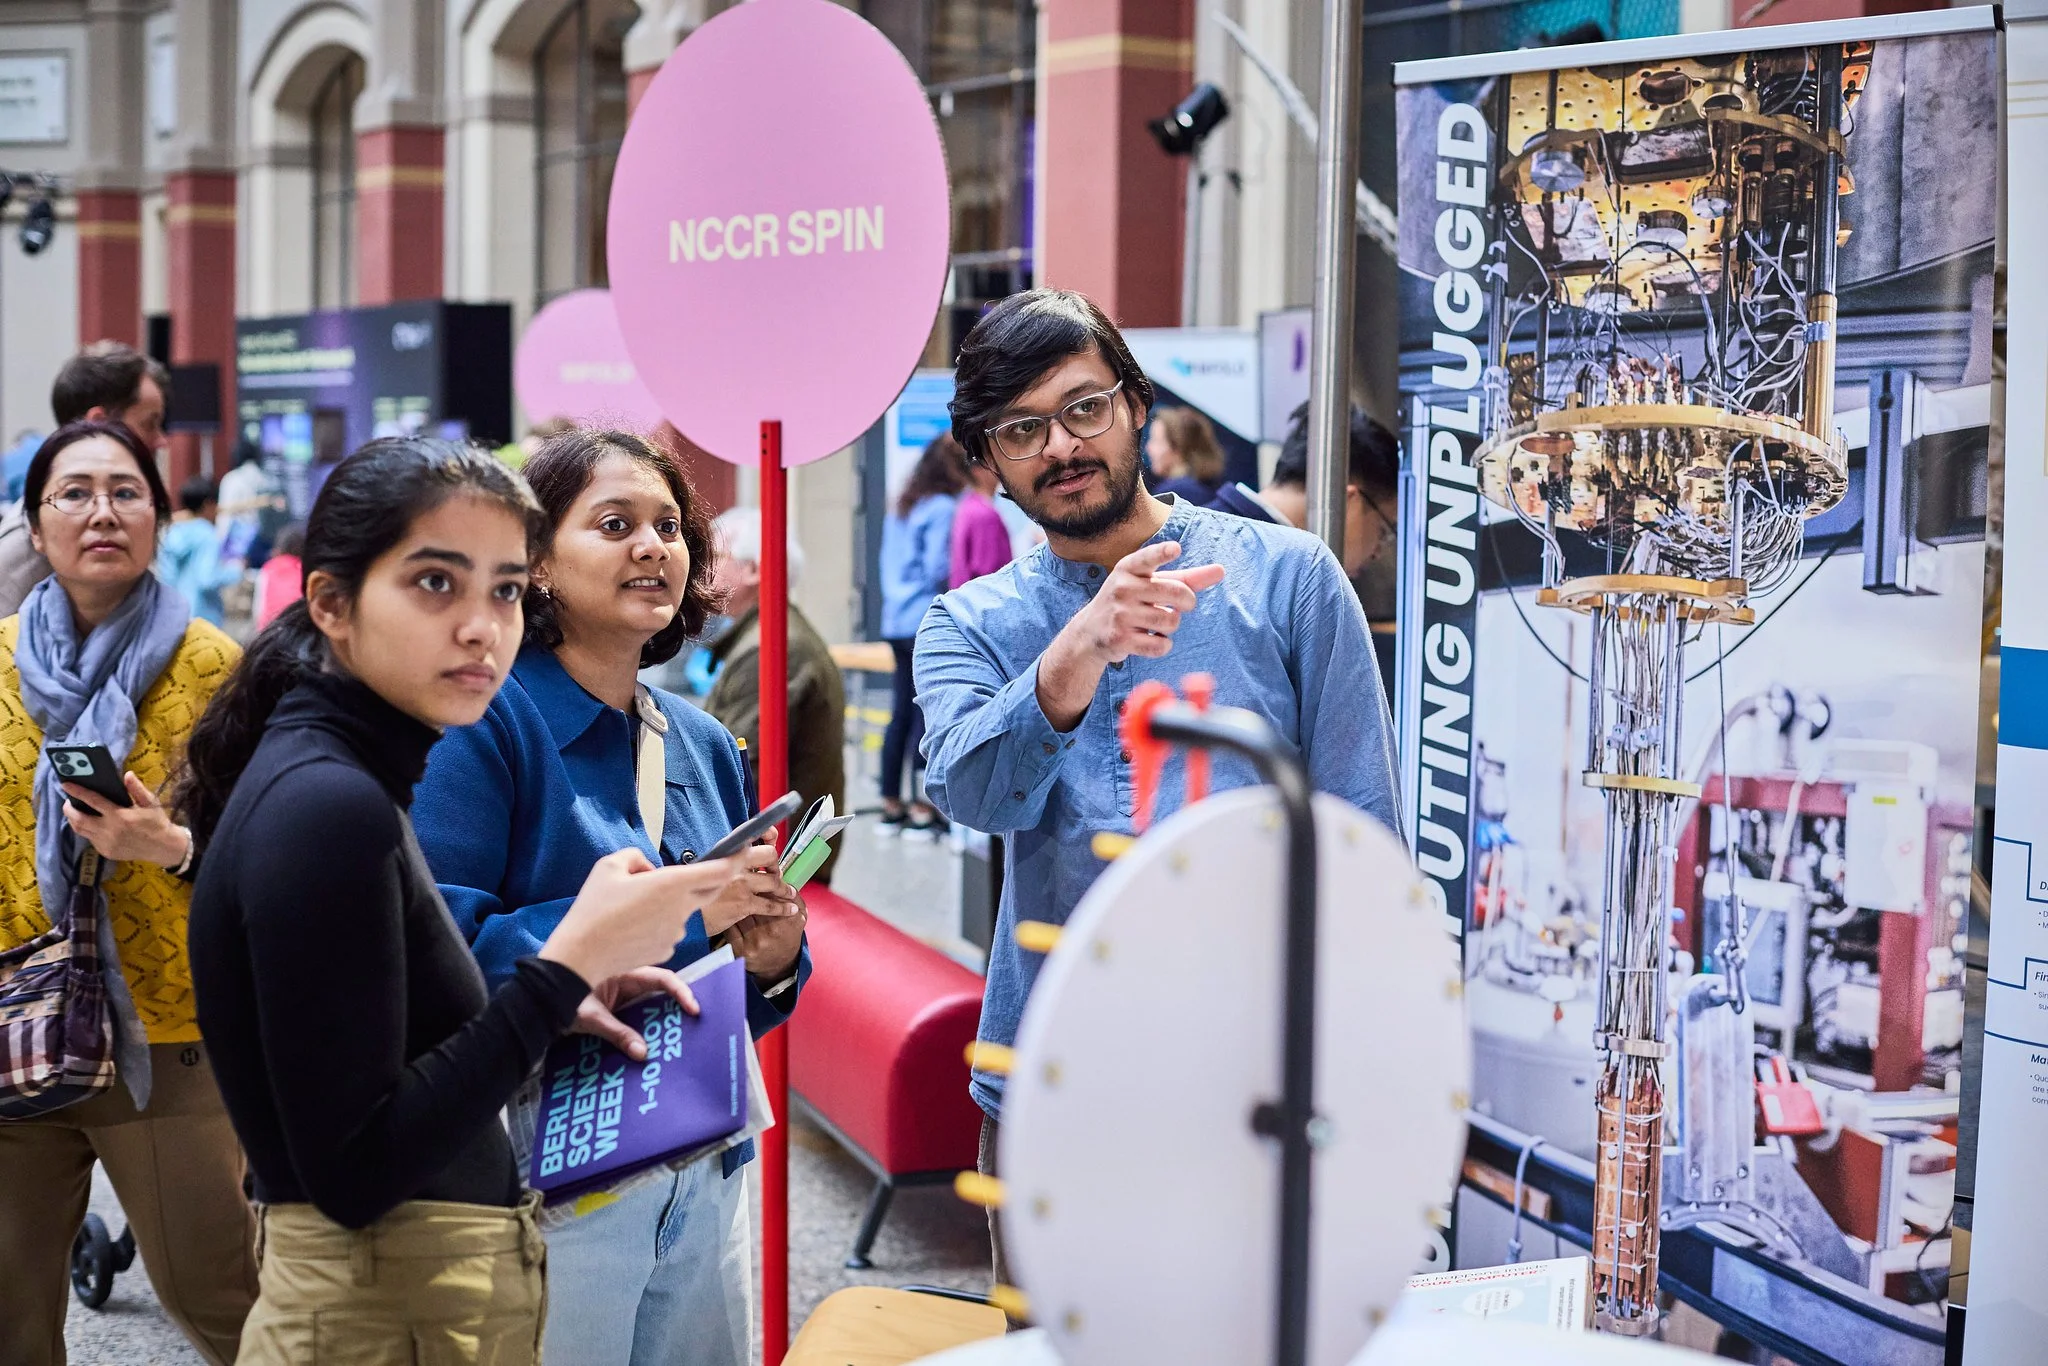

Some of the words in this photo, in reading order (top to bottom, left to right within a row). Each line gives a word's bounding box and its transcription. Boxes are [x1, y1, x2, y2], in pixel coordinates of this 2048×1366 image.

[669, 212, 780, 263] NCCR
[786, 205, 884, 256] SPIN
[1426, 102, 1488, 606] UNPLUGGED
[642, 1007, 662, 1060] NOV
[2031, 1053, 2048, 1064] Ma
[567, 1035, 600, 1169] SCIENCE
[593, 1063, 626, 1161] WEEK
[2032, 1085, 2045, 1093] are
[540, 1064, 575, 1177] BERLIN
[1410, 1280, 1452, 1288] YOUR
[1435, 1270, 1501, 1281] happens
[1504, 1264, 1549, 1273] inside
